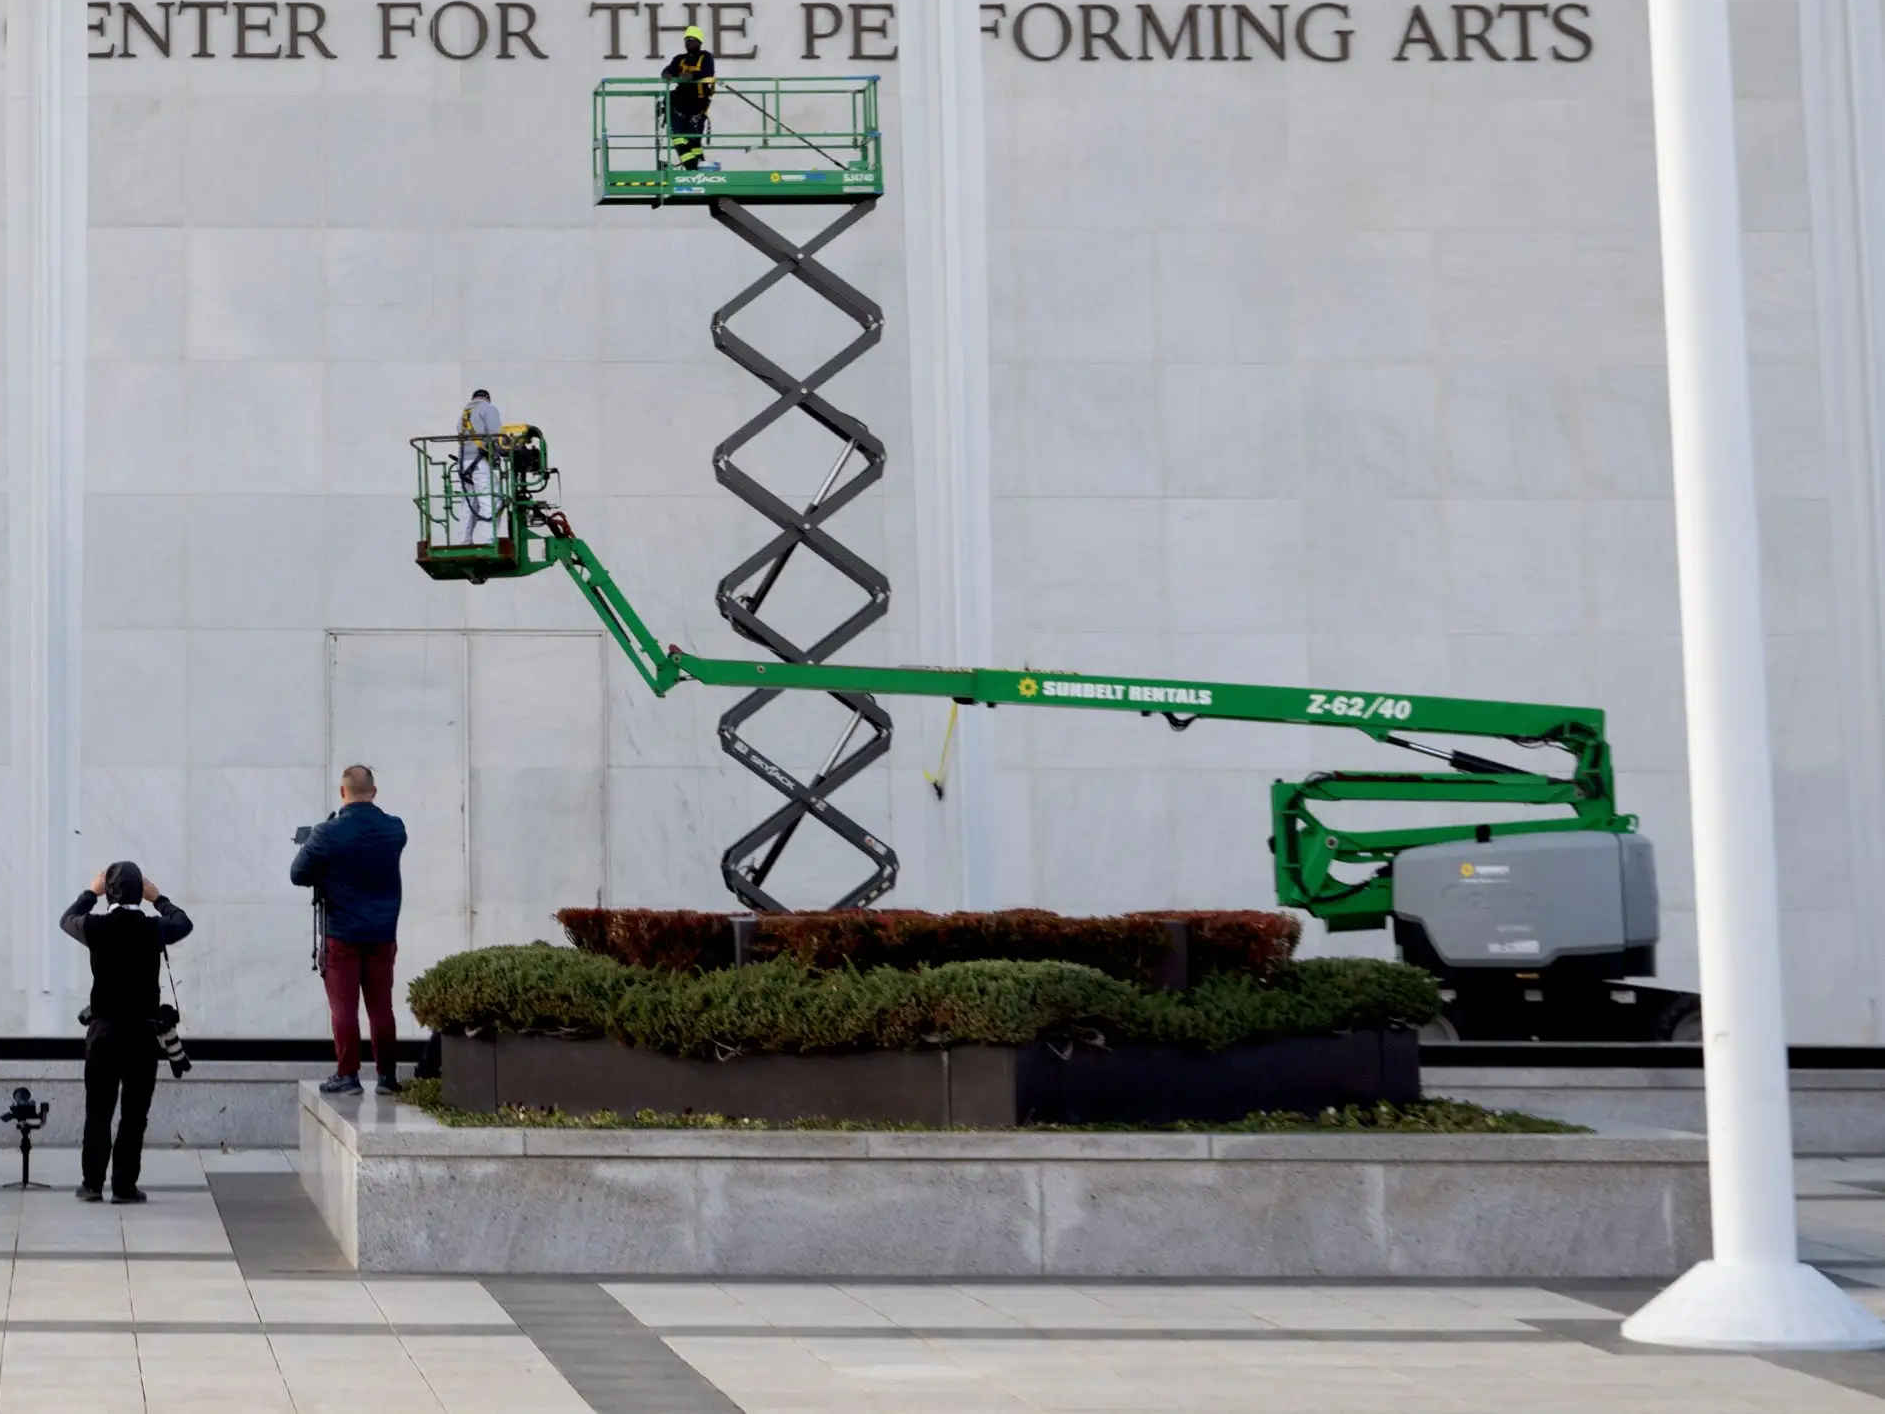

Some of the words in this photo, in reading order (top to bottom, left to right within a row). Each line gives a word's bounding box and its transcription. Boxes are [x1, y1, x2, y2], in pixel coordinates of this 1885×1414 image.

[3, 0, 338, 60] ENTER
[376, 0, 550, 61] FOR
[588, 0, 758, 61] THE
[799, 2, 1356, 64] PEFORMING
[1391, 1, 1594, 64] ARTS
[1042, 680, 1127, 701] SUNBELT
[1127, 685, 1213, 705] RENTALS
[1305, 693, 1413, 721] Z-62/40
